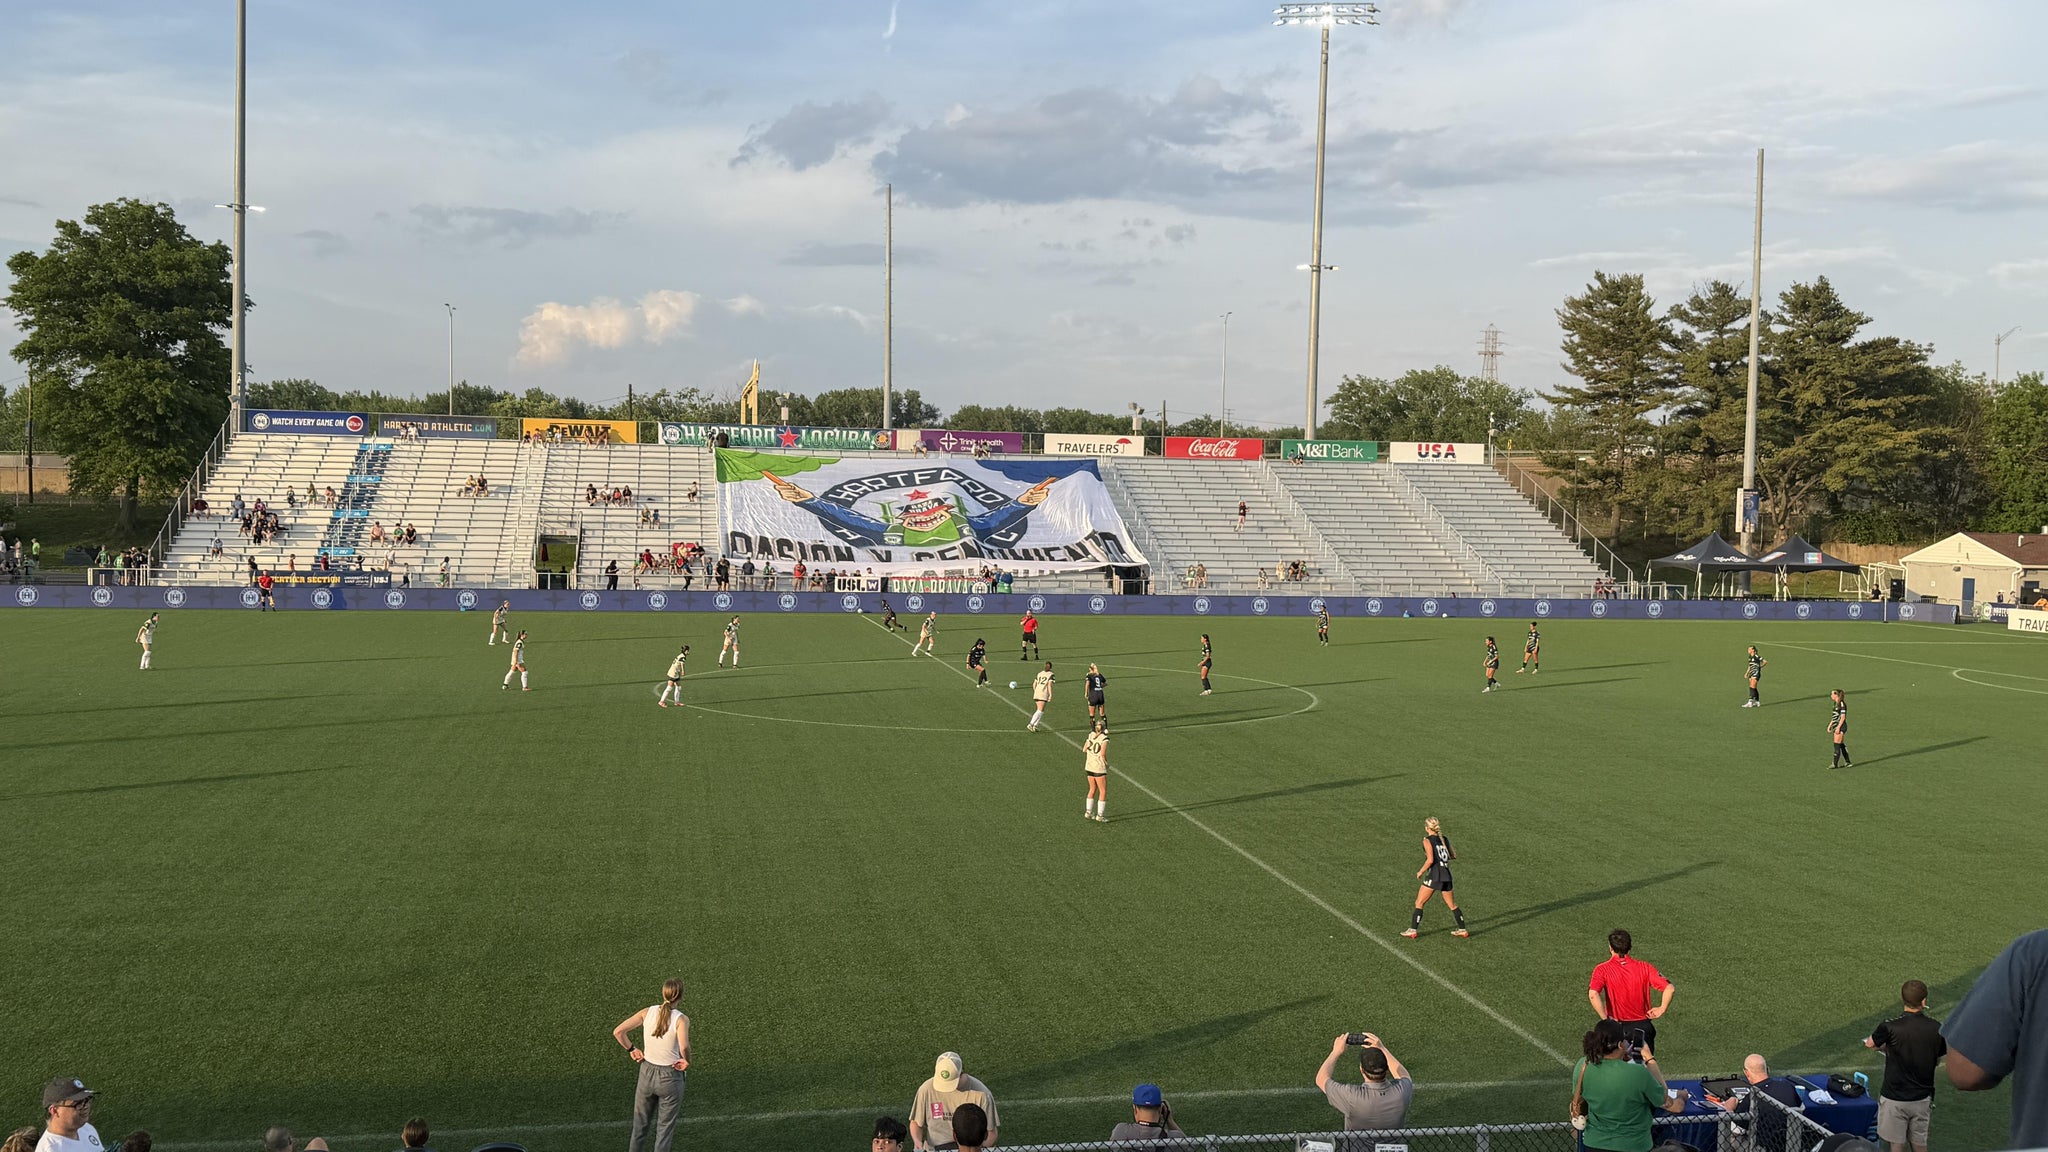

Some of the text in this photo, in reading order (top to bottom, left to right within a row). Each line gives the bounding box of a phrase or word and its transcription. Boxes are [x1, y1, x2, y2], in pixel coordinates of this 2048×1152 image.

[272, 417, 293, 426] WATCH
[294, 418, 315, 426] EVERY
[316, 418, 334, 427] GAME
[334, 419, 344, 427] ON
[801, 428, 871, 449] LOCURA
[1057, 442, 1119, 454] TRAVELERS
[1188, 438, 1239, 458] Coca-Cola
[1296, 443, 1364, 459] M&T Bank
[1417, 443, 1457, 459] USA
[828, 469, 1004, 503] HARTFORD
[307, 575, 341, 584] SECTION
[1038, 676, 1048, 685] 12
[1095, 677, 1100, 688] 9
[1087, 739, 1101, 754] 20
